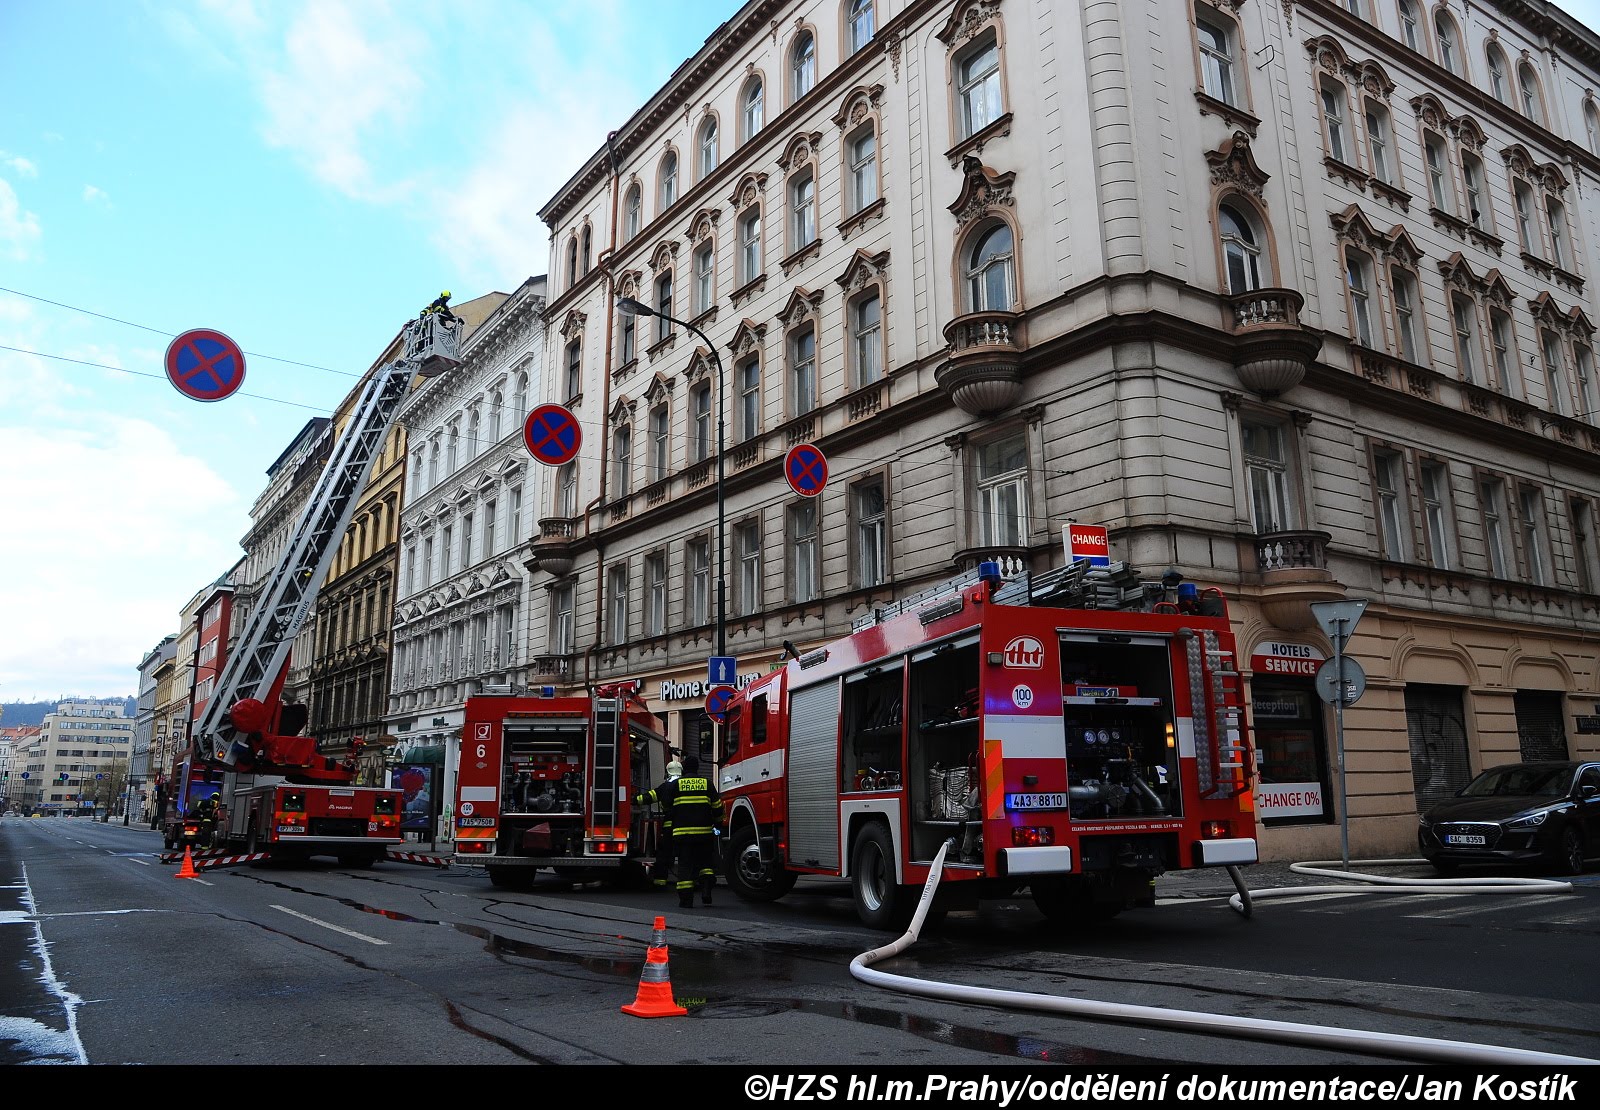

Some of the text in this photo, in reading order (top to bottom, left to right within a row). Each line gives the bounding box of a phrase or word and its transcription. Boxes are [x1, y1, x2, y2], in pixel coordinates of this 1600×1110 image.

[1071, 534, 1106, 546] CHANGE
[292, 600, 310, 630] MAGIRUS
[1271, 643, 1310, 657] HOTELS
[1265, 658, 1316, 674] SERVICE
[660, 679, 700, 701] iPhone
[1014, 688, 1032, 701] 100
[476, 744, 486, 758] 6
[1013, 794, 1063, 807] 4A3 8810
[1304, 791, 1320, 806] 0%
